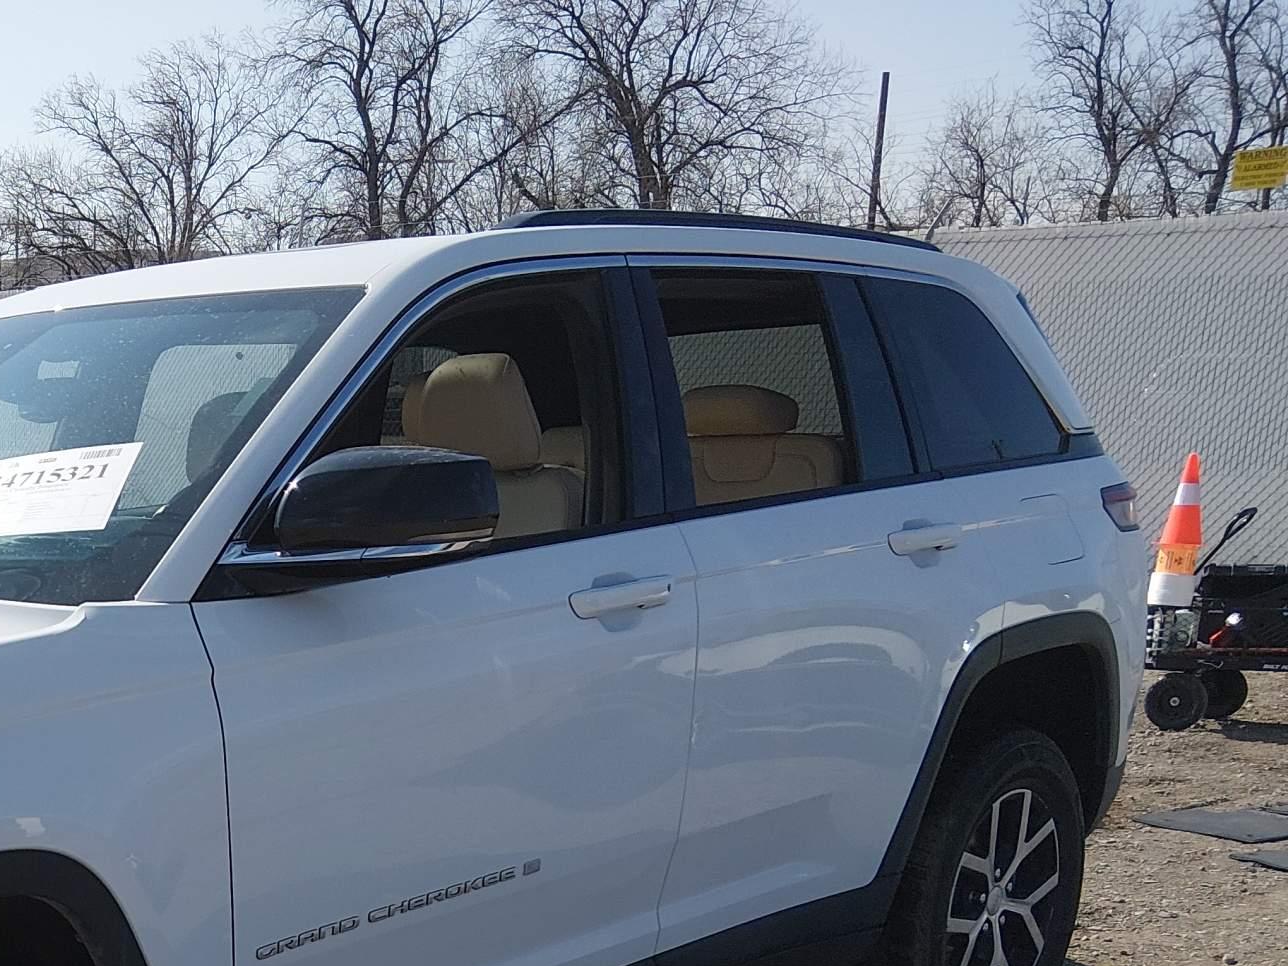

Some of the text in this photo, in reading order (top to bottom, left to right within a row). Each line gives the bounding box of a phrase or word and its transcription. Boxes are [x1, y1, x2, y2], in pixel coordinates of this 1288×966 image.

[1239, 148, 1288, 161] WARNING
[256, 866, 516, 960] GRAND CHEROKEE
